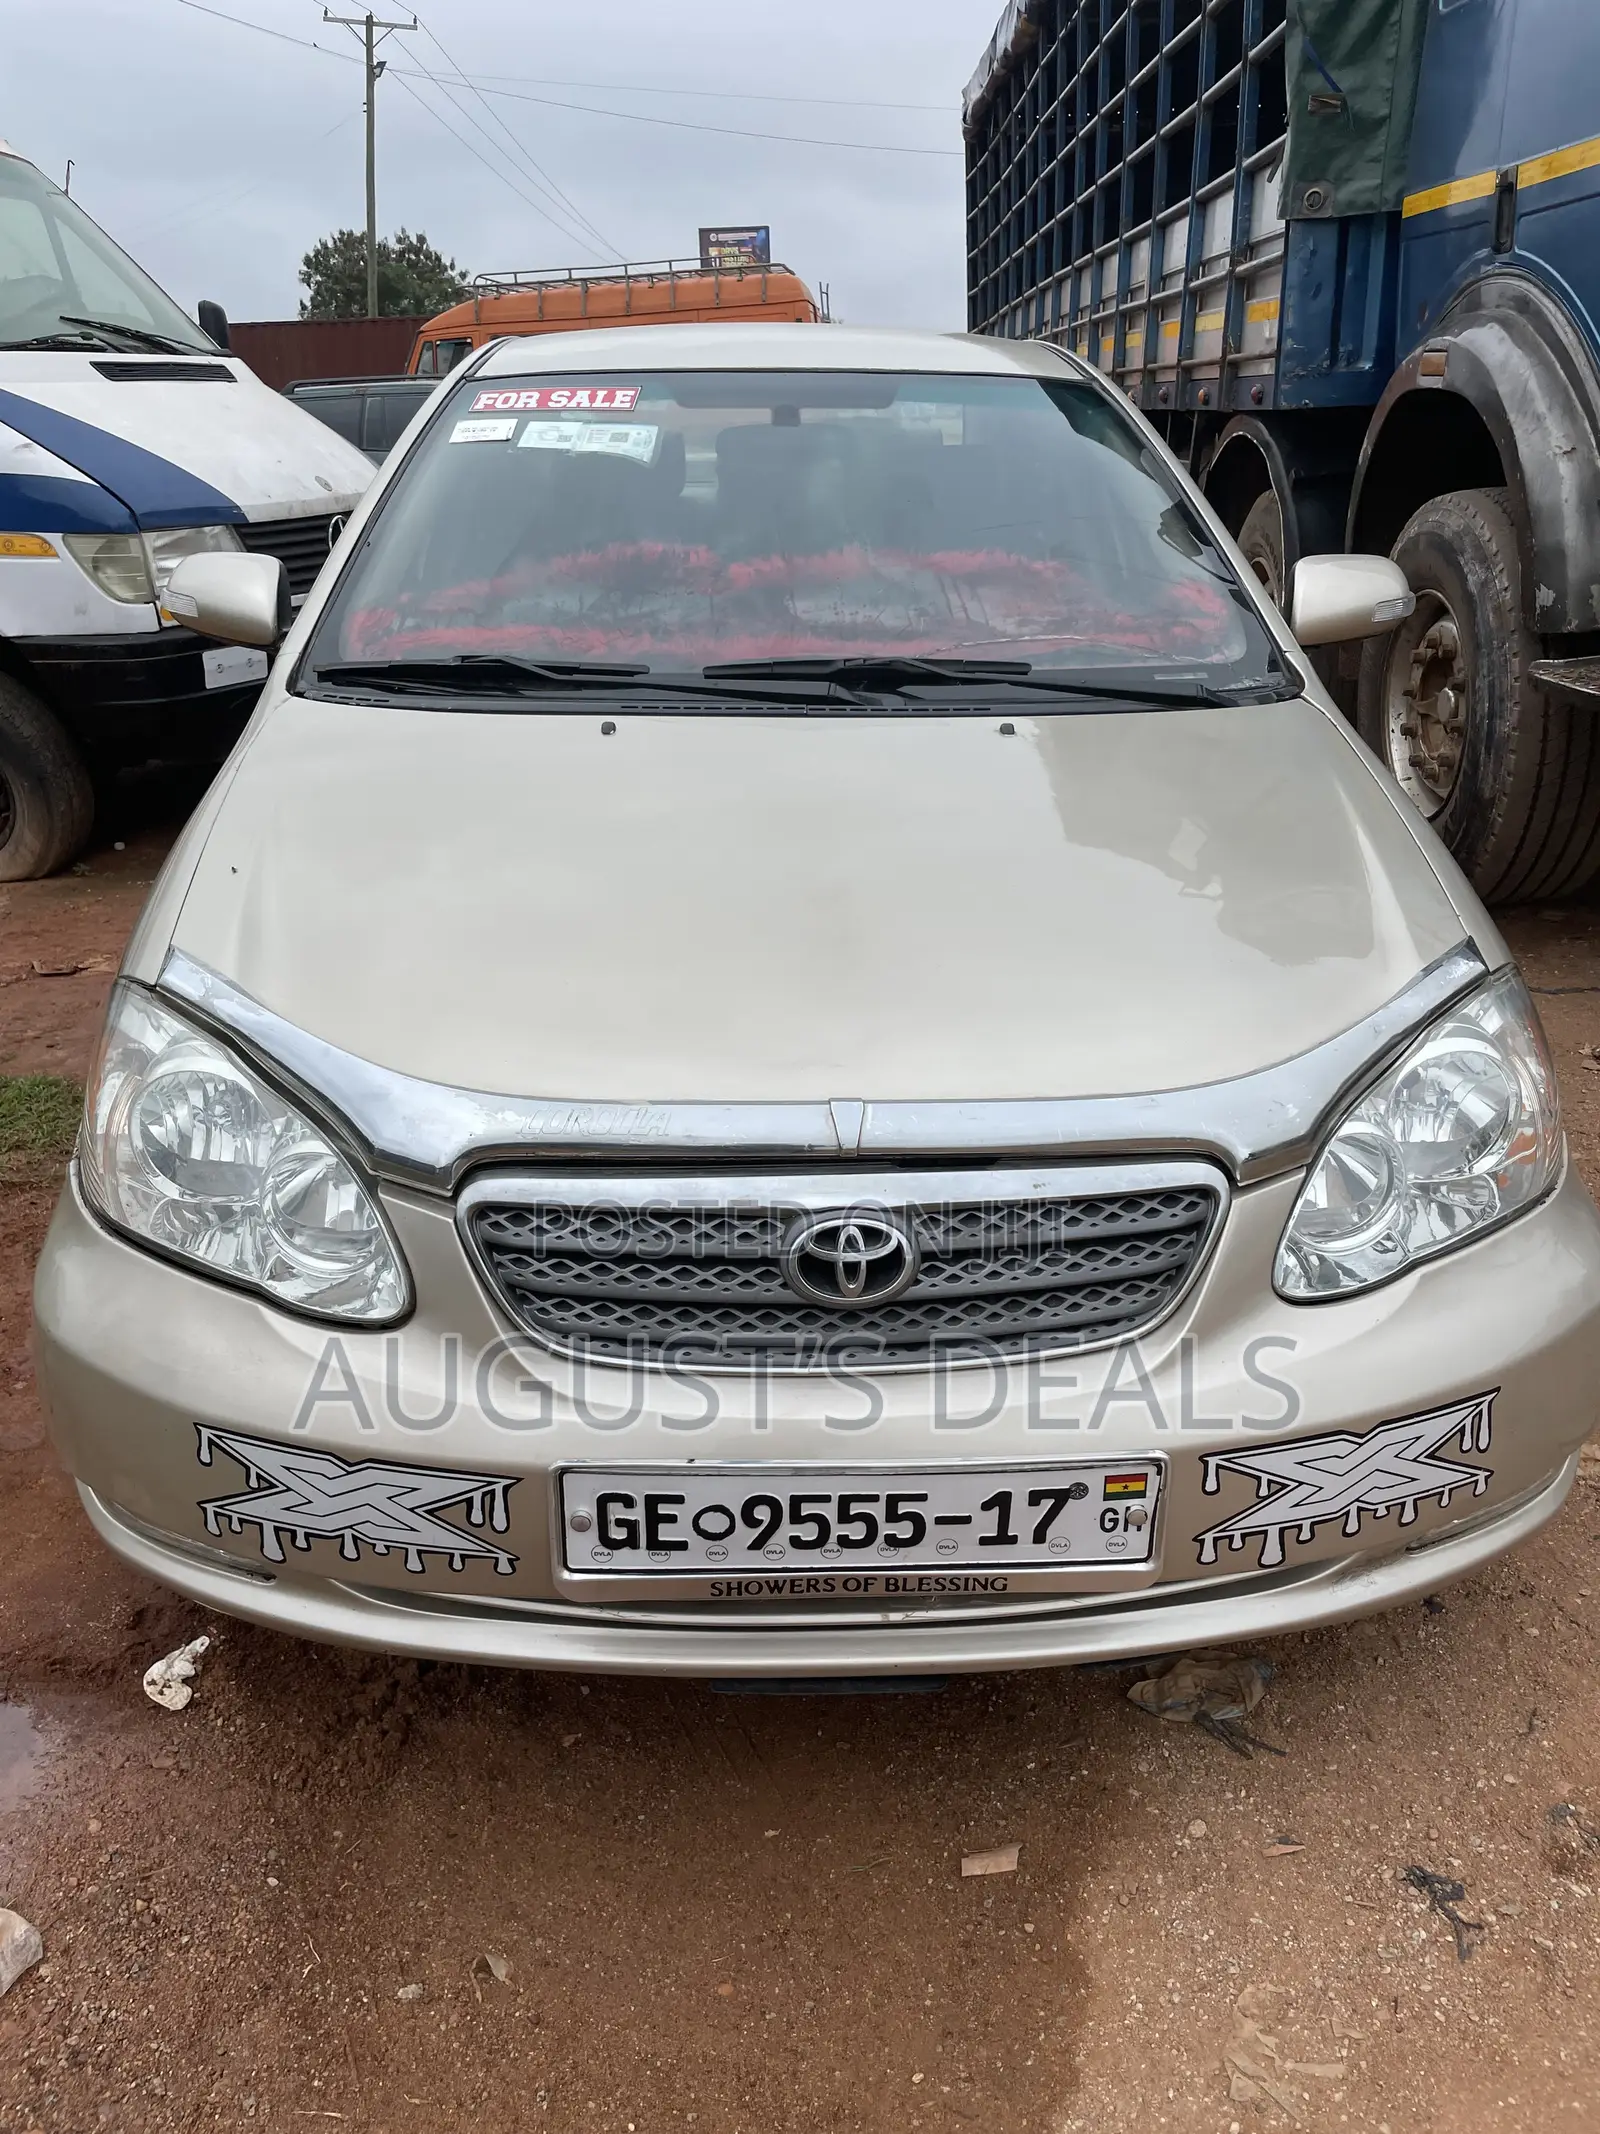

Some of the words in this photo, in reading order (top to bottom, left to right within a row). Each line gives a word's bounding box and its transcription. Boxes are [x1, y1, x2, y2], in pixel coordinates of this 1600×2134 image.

[473, 392, 540, 409] FOR
[548, 390, 635, 408] SALE
[710, 1577, 837, 1597] SHOWERS
[842, 1577, 877, 1594] OF
[885, 1576, 1009, 1592] BLESSING
